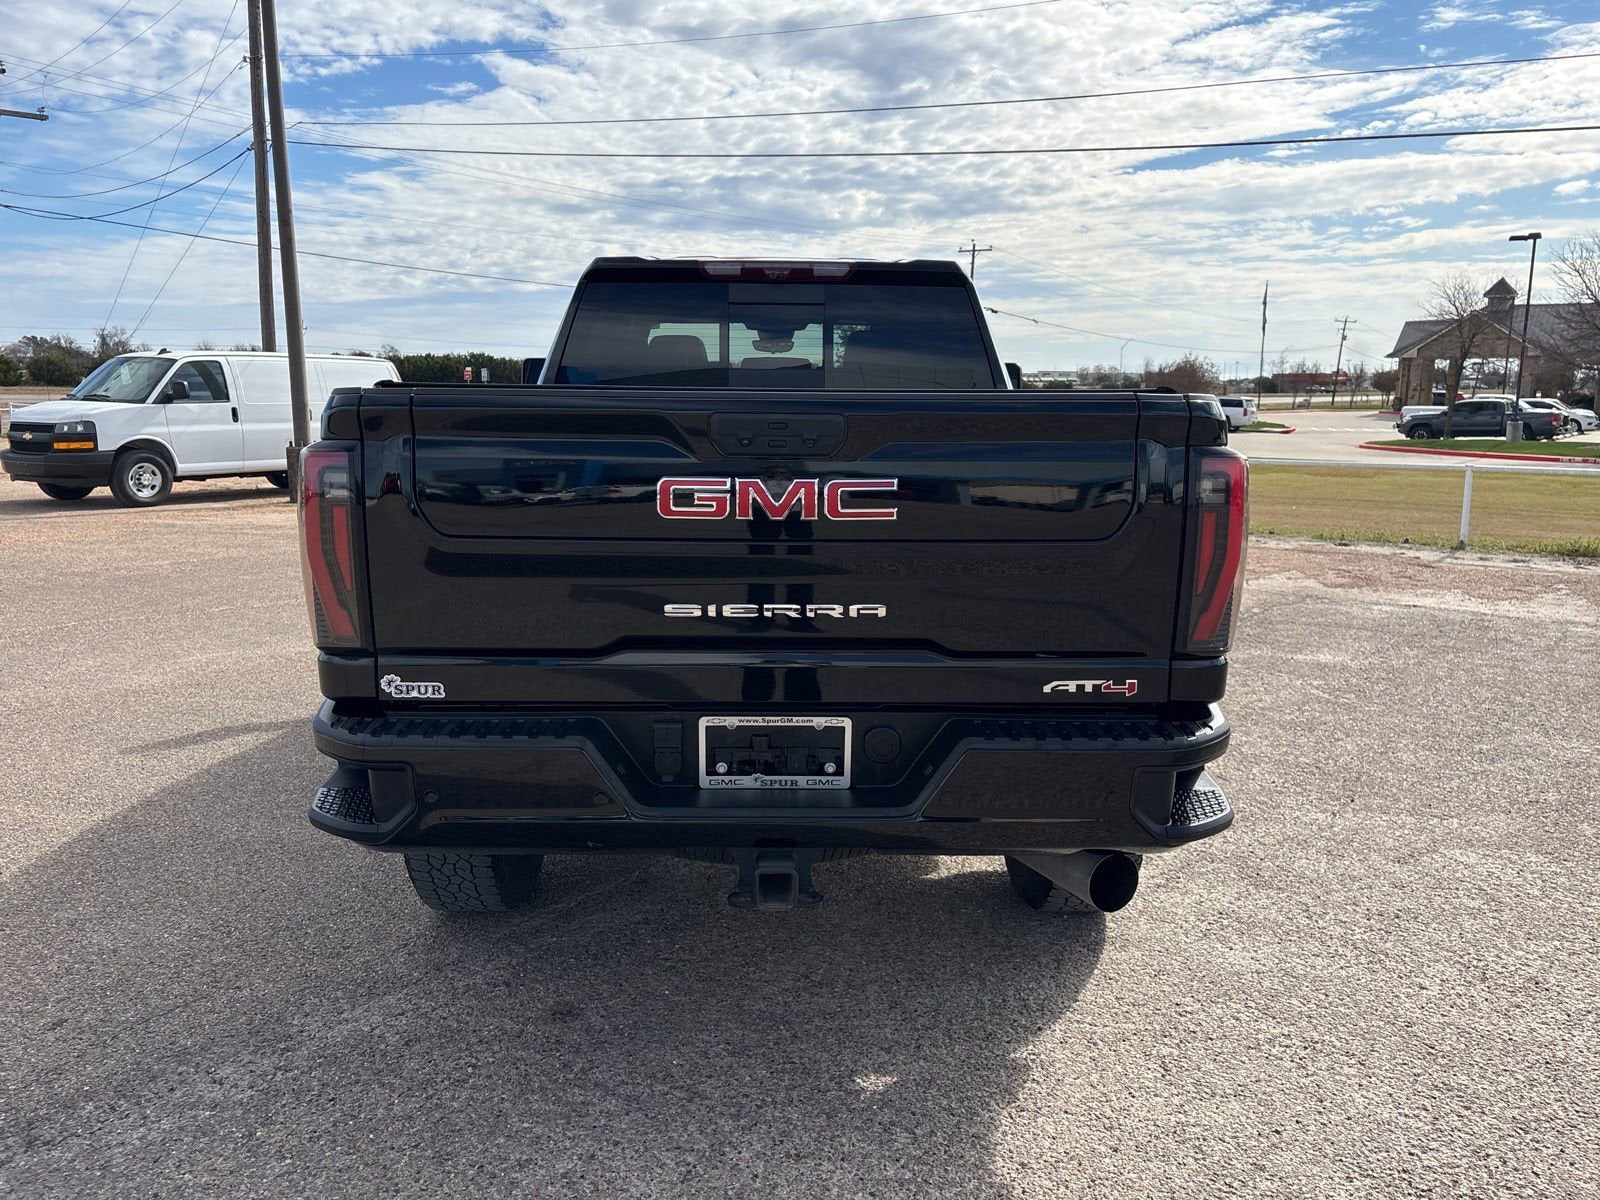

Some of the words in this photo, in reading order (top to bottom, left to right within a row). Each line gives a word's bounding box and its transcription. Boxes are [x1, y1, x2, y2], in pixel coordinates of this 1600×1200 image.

[656, 477, 898, 521] GMC
[663, 603, 887, 618] SIERRA
[394, 684, 442, 696] SPUR
[1042, 679, 1138, 697] AT4
[737, 717, 814, 725] www.SpurGM.com
[760, 779, 800, 787] SPUR
